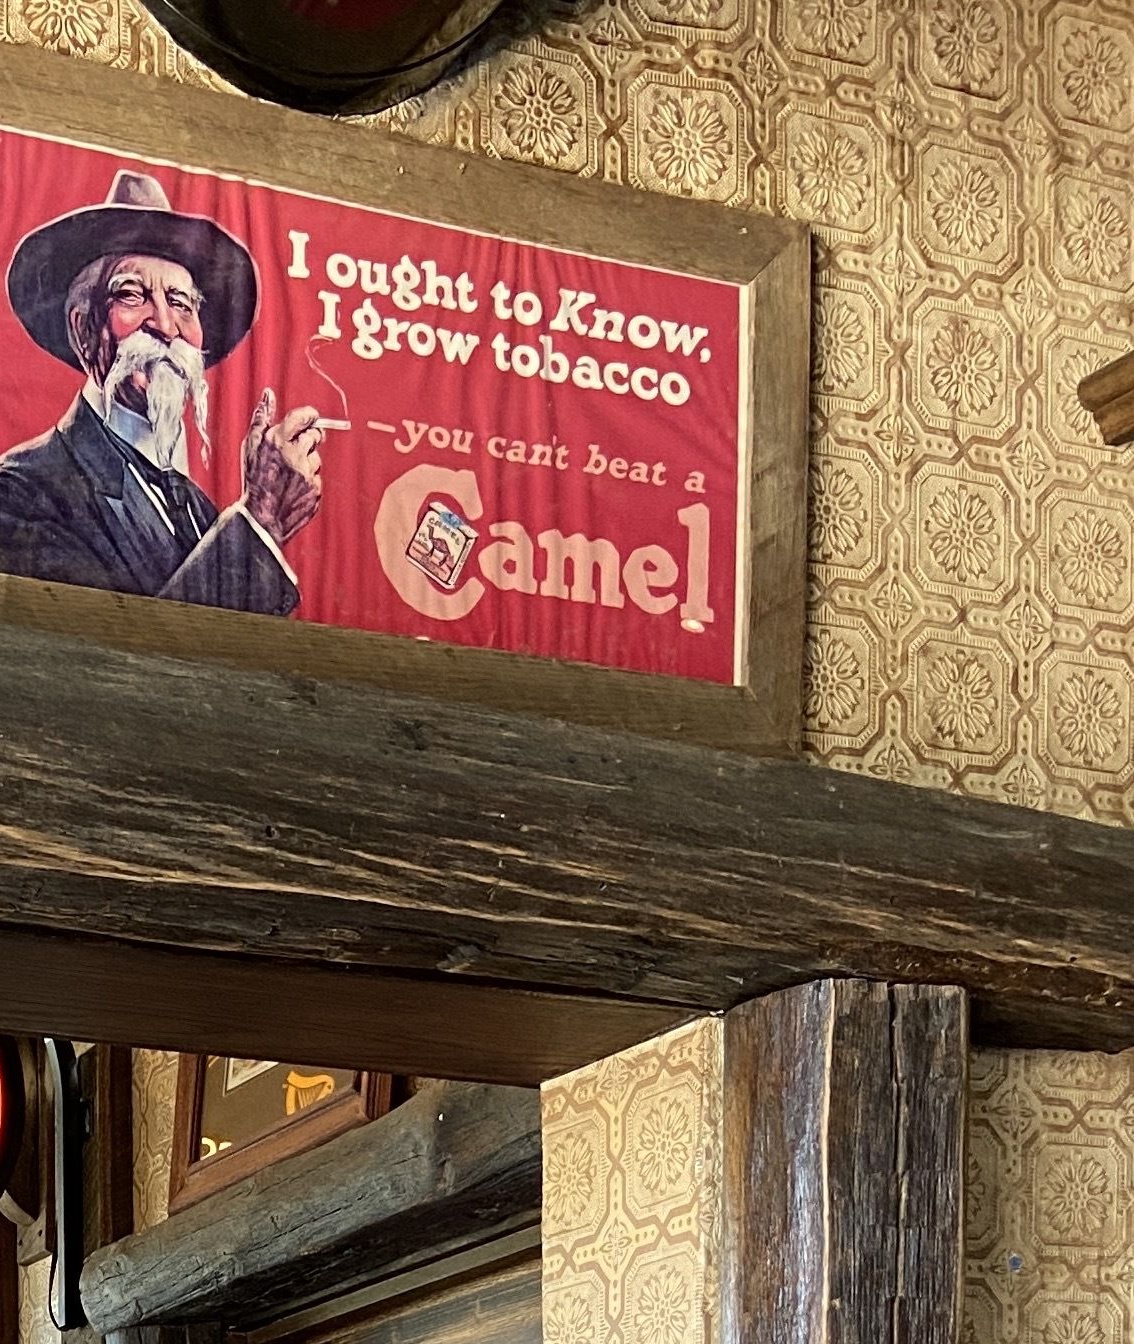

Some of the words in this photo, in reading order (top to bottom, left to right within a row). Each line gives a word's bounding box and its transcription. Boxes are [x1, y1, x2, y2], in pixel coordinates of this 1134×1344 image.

[287, 230, 310, 279] I
[326, 255, 478, 313] ought
[491, 280, 543, 325] to
[549, 289, 712, 364] Know,
[318, 291, 342, 340] I
[351, 298, 480, 366] grow
[491, 331, 690, 406] tobacco
[487, 434, 569, 470] can't
[583, 445, 667, 486] beat
[684, 471, 706, 493] a
[374, 464, 714, 624] Camel
